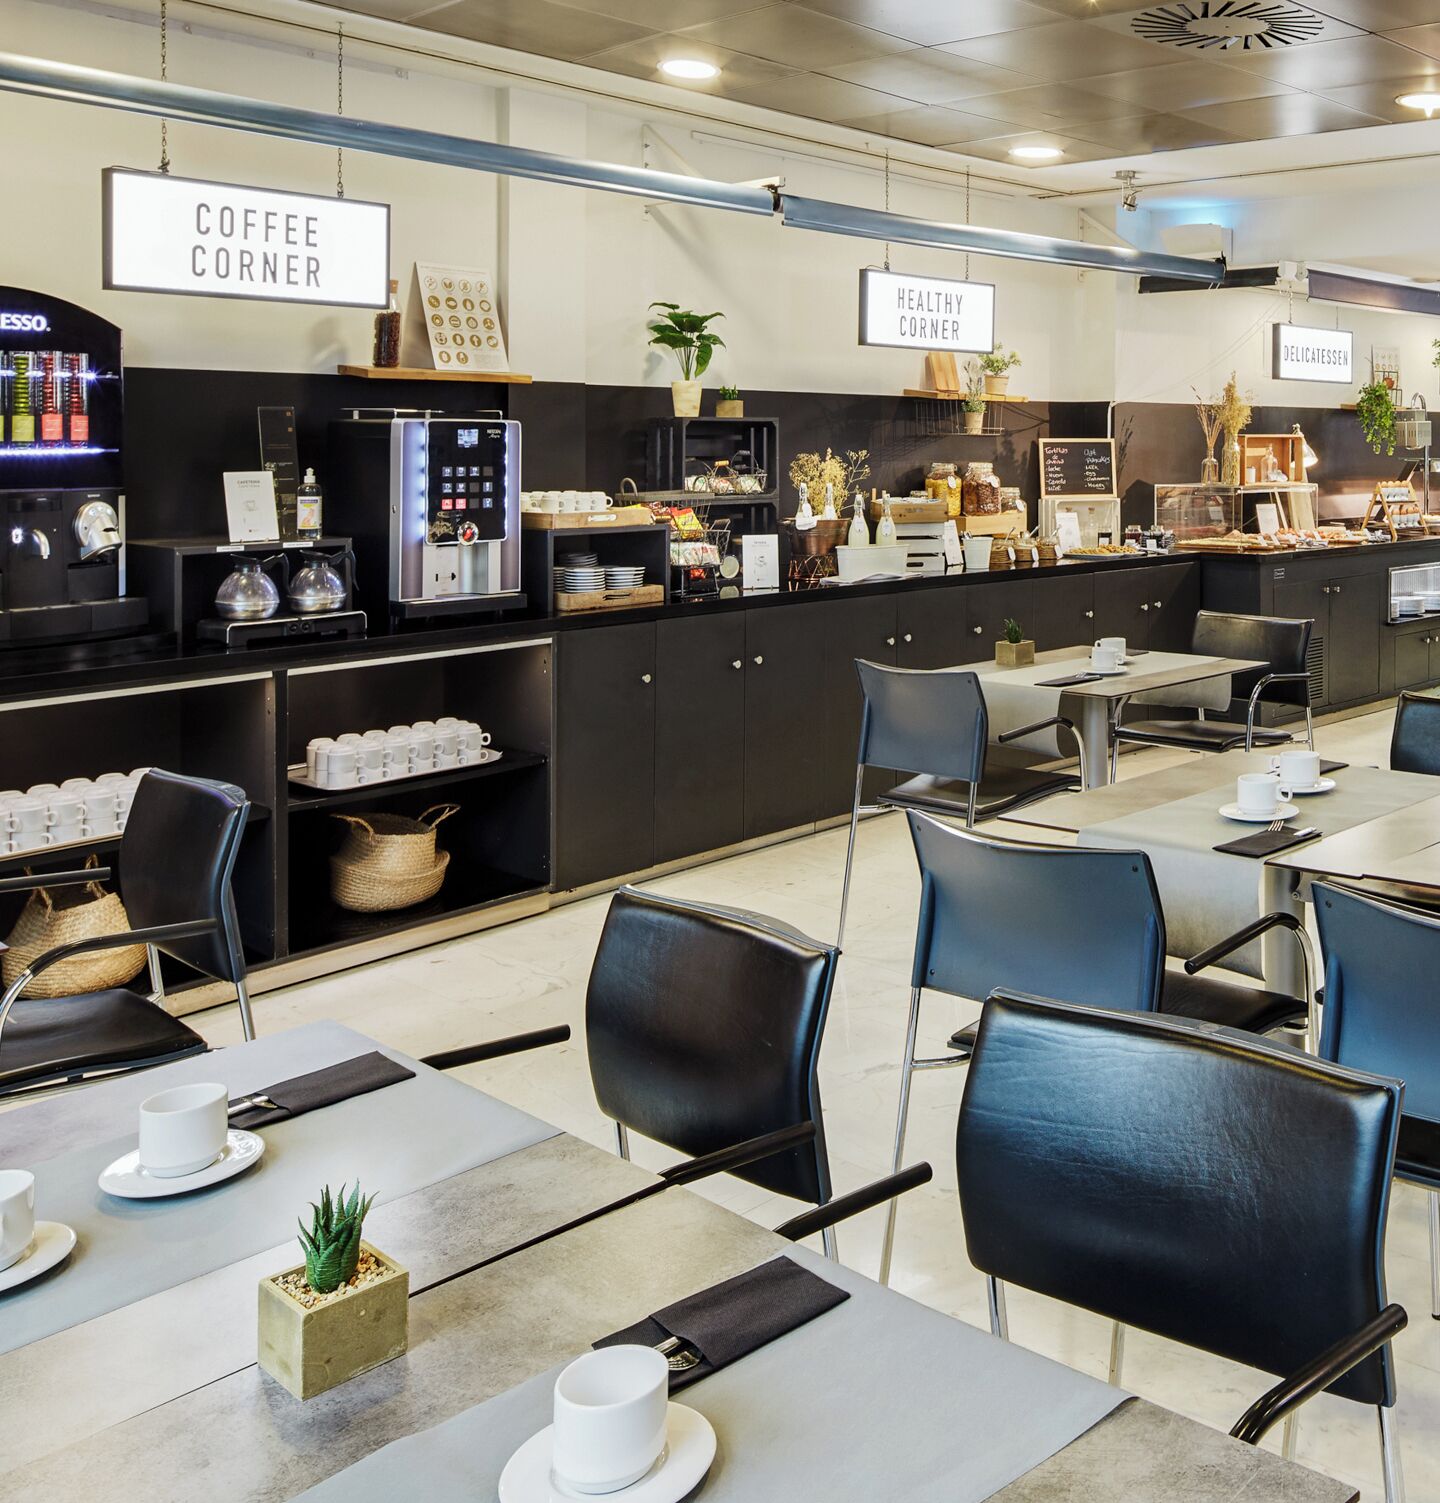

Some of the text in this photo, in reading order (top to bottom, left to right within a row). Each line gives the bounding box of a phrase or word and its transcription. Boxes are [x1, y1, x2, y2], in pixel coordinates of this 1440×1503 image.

[196, 202, 318, 248] COFFEE
[192, 244, 321, 288] CORNER
[897, 287, 963, 315] HEALTHY
[899, 315, 960, 341] CORNER
[1284, 344, 1349, 366] DELICATESSEN
